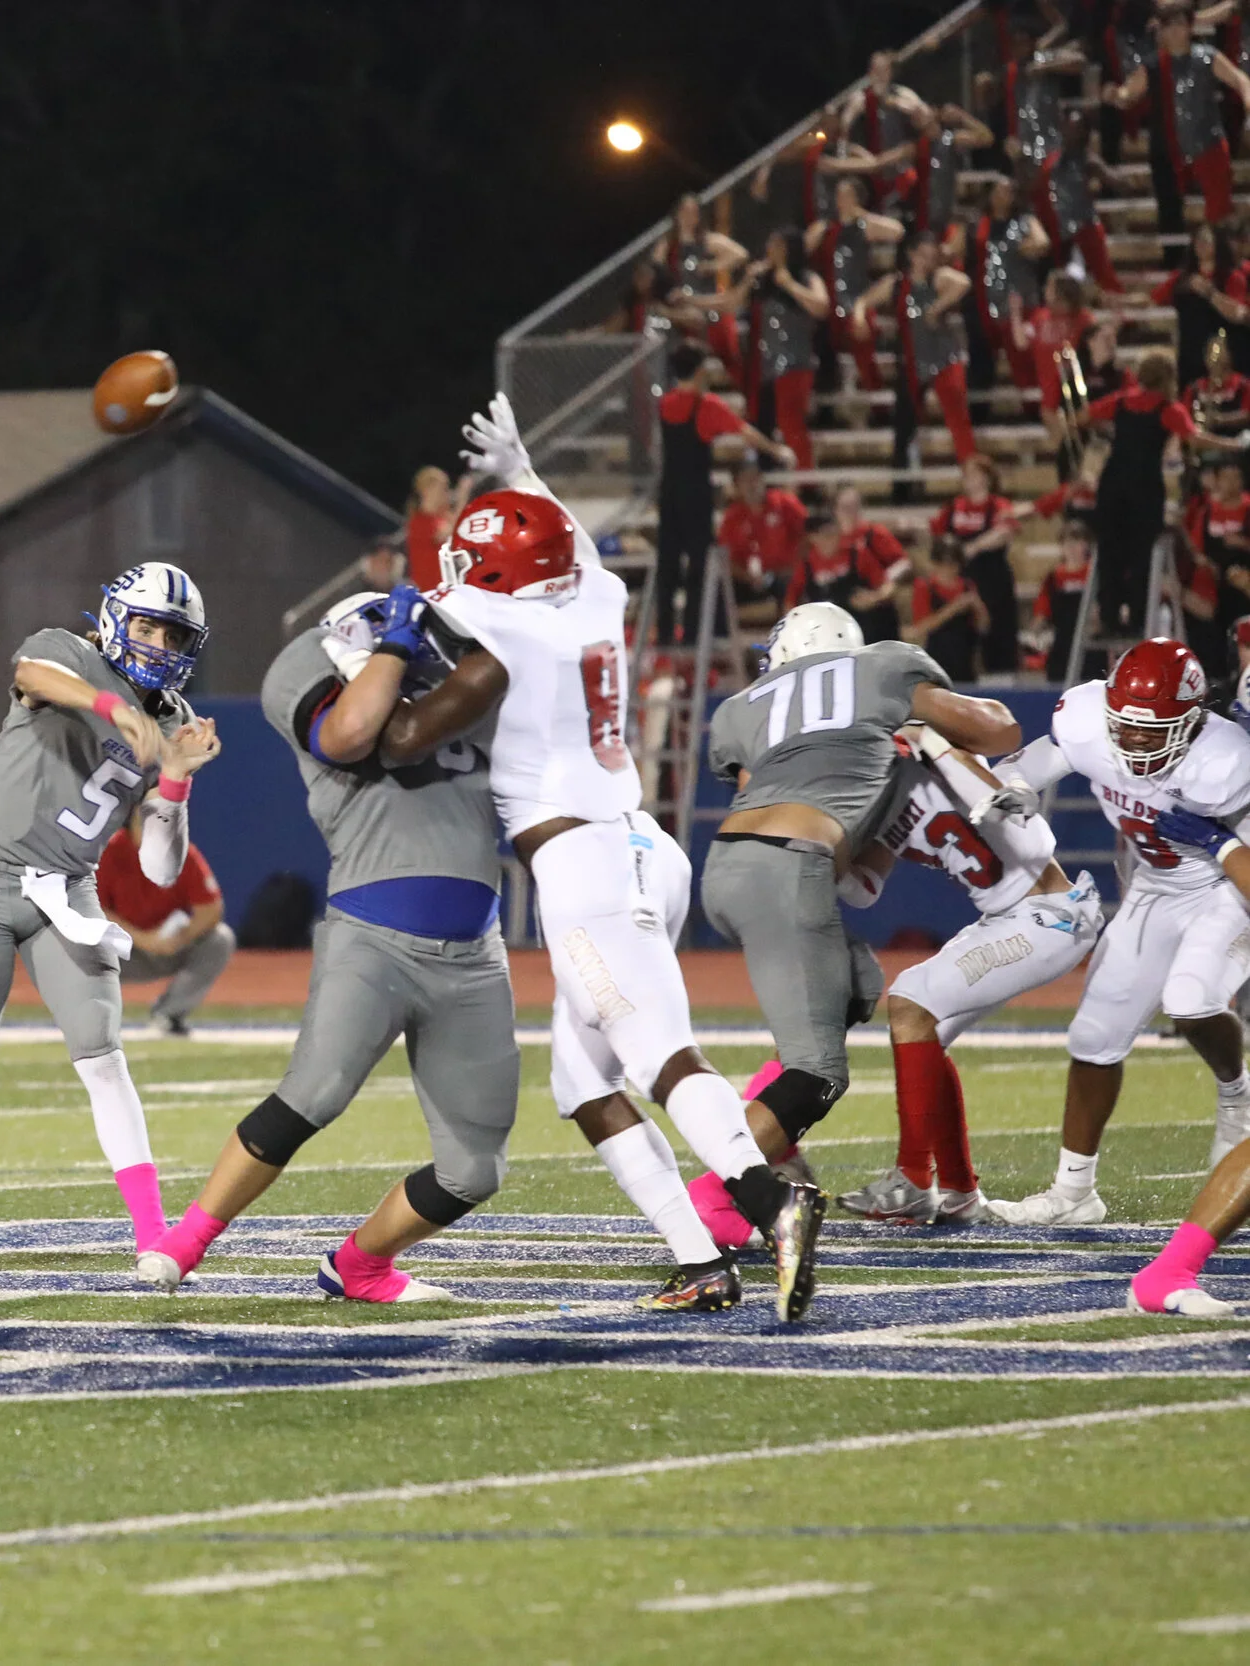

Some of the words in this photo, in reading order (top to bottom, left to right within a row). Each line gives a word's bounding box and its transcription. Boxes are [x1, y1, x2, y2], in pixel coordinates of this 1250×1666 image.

[469, 517, 489, 533] B
[748, 656, 856, 748] 70
[56, 756, 143, 841] 5
[1102, 784, 1161, 820] BILOX
[955, 932, 1034, 988] INDIANS
